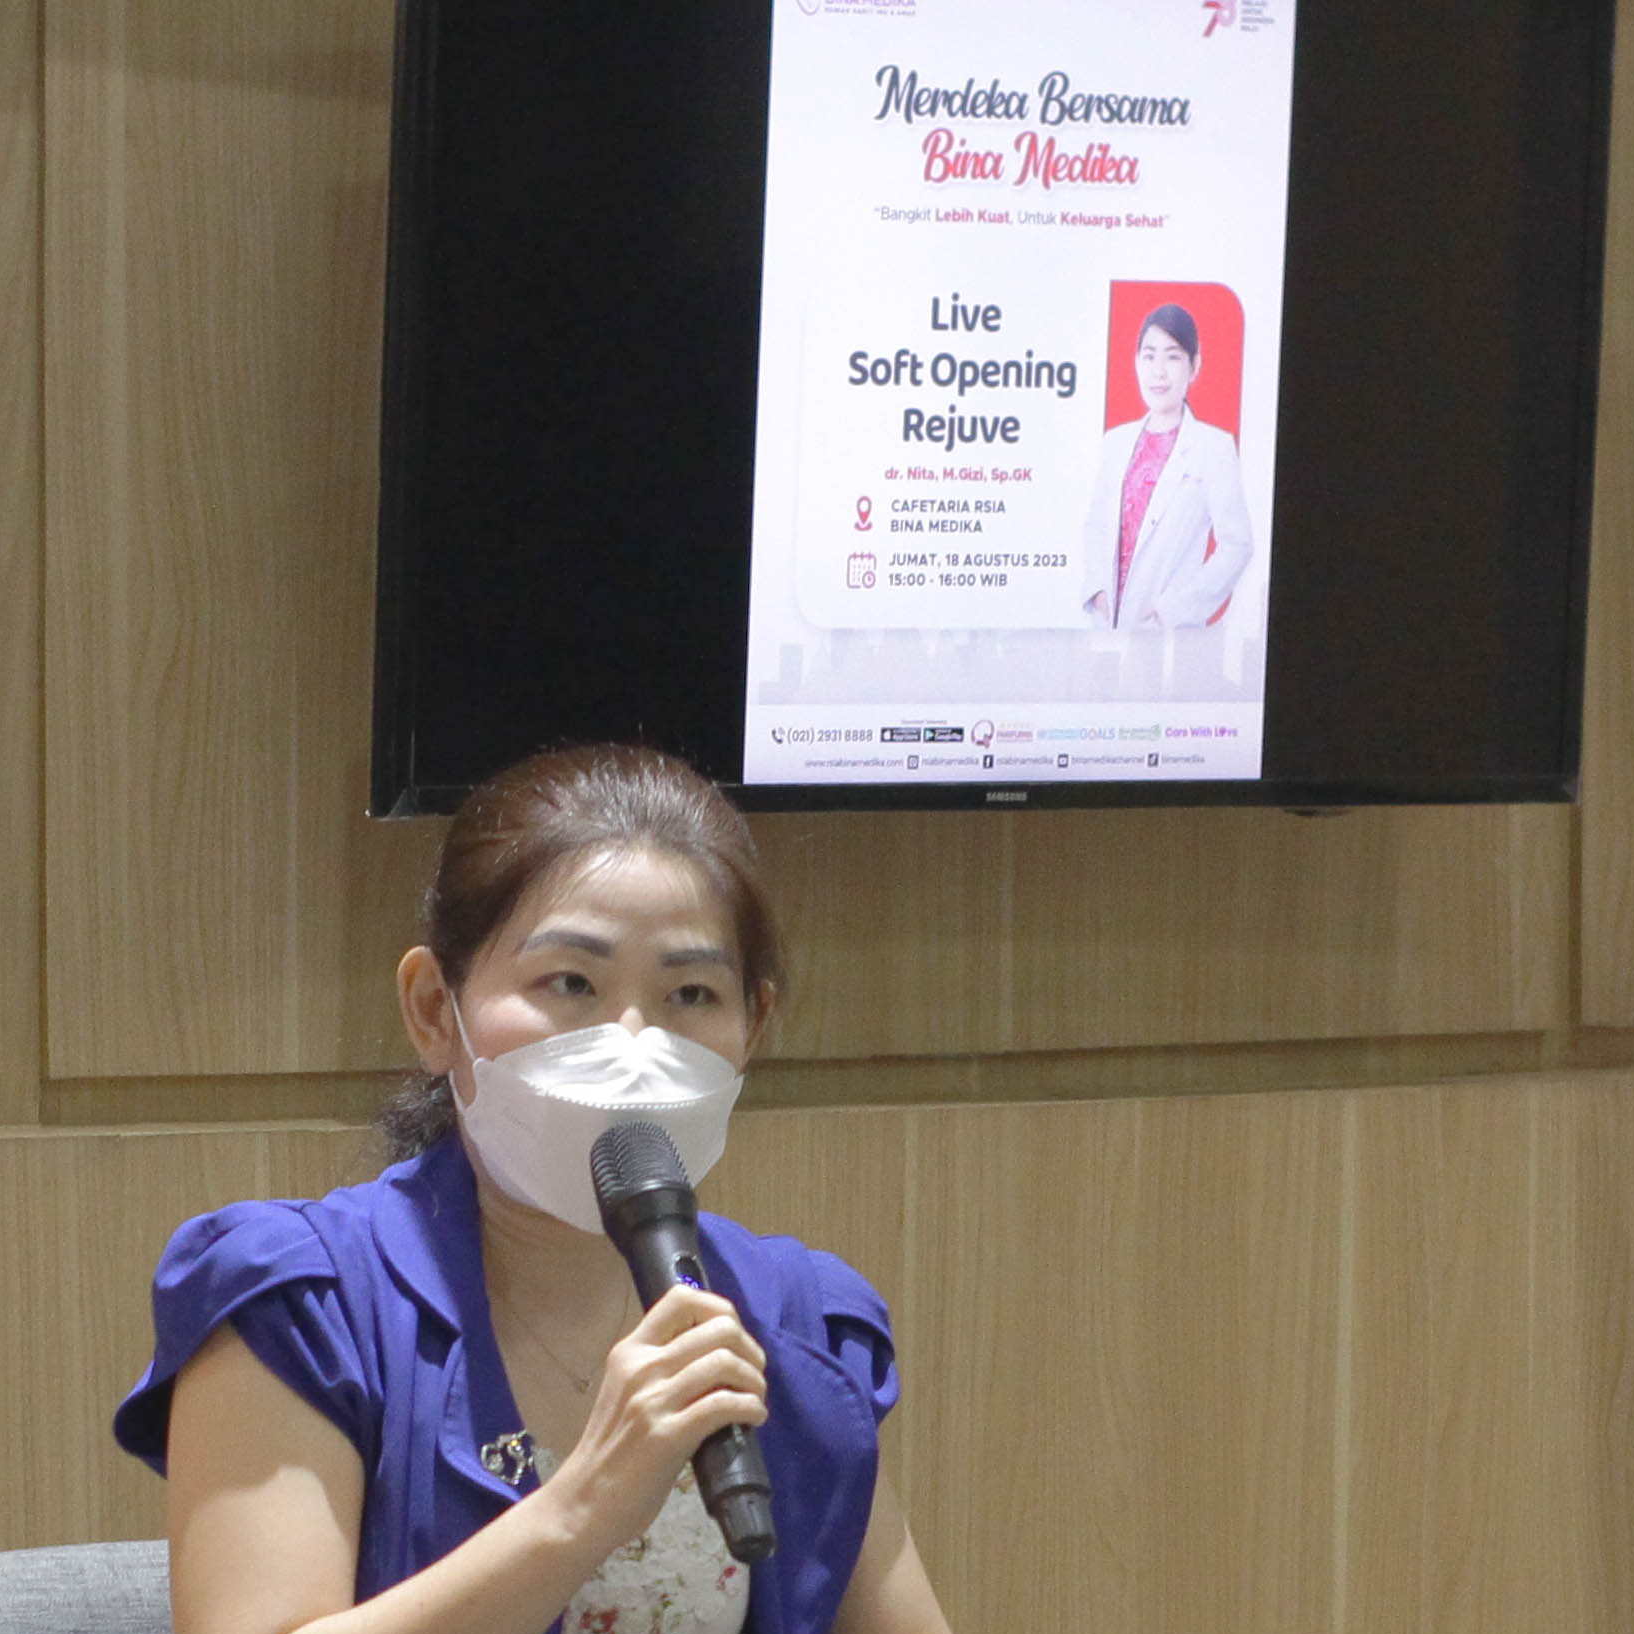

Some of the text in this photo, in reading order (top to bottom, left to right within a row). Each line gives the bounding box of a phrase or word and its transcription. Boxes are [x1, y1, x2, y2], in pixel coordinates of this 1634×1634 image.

[873, 64, 1191, 127] Merdeka Bersama
[922, 128, 1140, 190] Bina Medika
[935, 207, 973, 222] Lebih
[977, 209, 1013, 227] Kuat,
[1017, 210, 1057, 226] Untuk
[1060, 211, 1122, 230] Keluarga
[930, 292, 1002, 332] Live
[848, 349, 1077, 398] Soft Opening
[903, 406, 1021, 452] Rejuve
[884, 466, 903, 481] dr.
[907, 467, 939, 484] Nita,
[991, 467, 1032, 484] Sp.GK
[890, 499, 1007, 514] CAFETARIA RSIA
[890, 519, 983, 534] BINA MEDIKA
[888, 553, 1068, 569] JUMAT, 18 AGUSTUS 2023
[888, 573, 925, 588] 15:00
[939, 573, 976, 588] 16:00
[979, 573, 1008, 587] WIB
[787, 728, 874, 744] (021) 2931 8888
